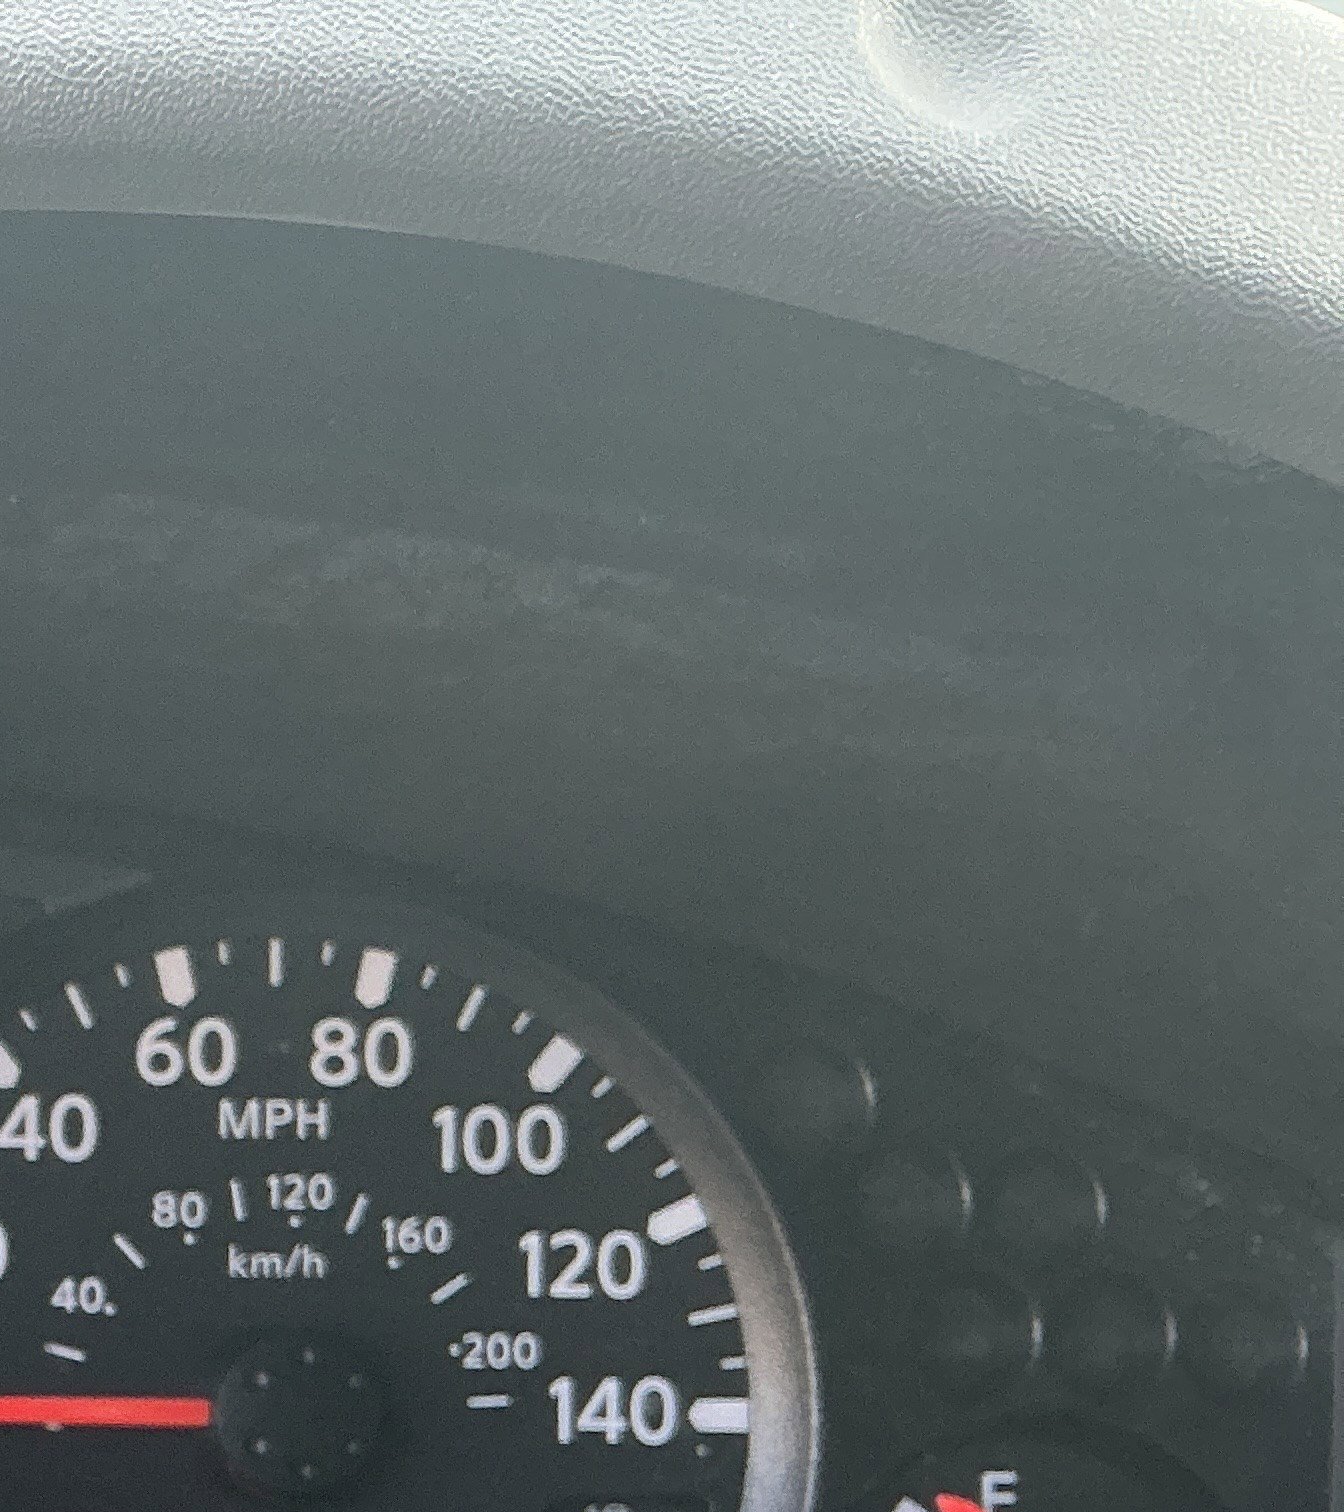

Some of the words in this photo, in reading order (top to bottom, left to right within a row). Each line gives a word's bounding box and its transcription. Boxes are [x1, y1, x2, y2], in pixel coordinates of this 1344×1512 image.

[135, 1017, 238, 1087] 60
[310, 1017, 413, 1088] 80
[218, 1098, 329, 1139] MPH
[433, 1104, 565, 1175] 100
[152, 1191, 207, 1228] 80
[267, 1173, 334, 1211] 120
[382, 1216, 451, 1255] 160
[228, 1245, 325, 1278] km/h
[519, 1231, 647, 1301] 120
[50, 1276, 103, 1314] 40
[462, 1331, 539, 1370] 200
[549, 1376, 678, 1446] 140
